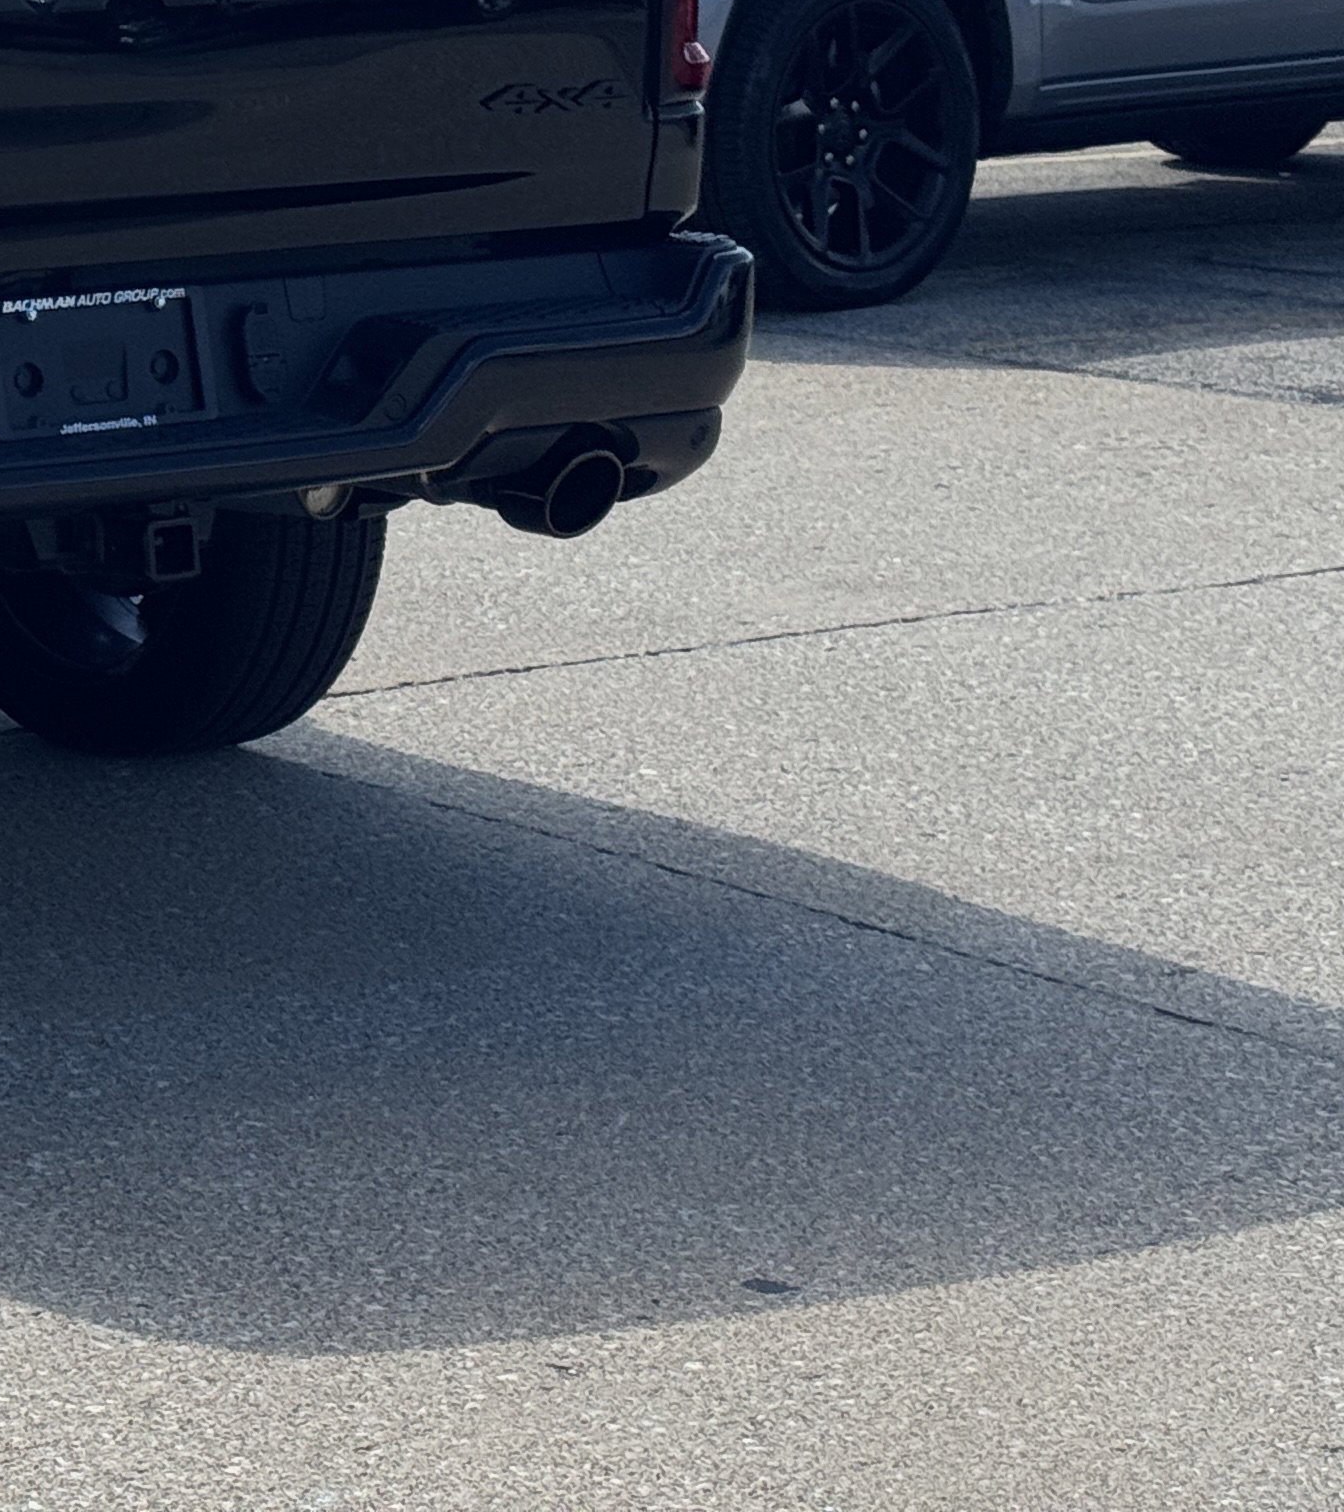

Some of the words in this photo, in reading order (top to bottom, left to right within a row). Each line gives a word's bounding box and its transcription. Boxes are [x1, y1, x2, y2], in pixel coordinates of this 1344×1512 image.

[2, 295, 76, 314] BACHMAN
[77, 292, 112, 307] AUTO
[114, 287, 185, 303] GROUPcom
[143, 414, 157, 426] IN
